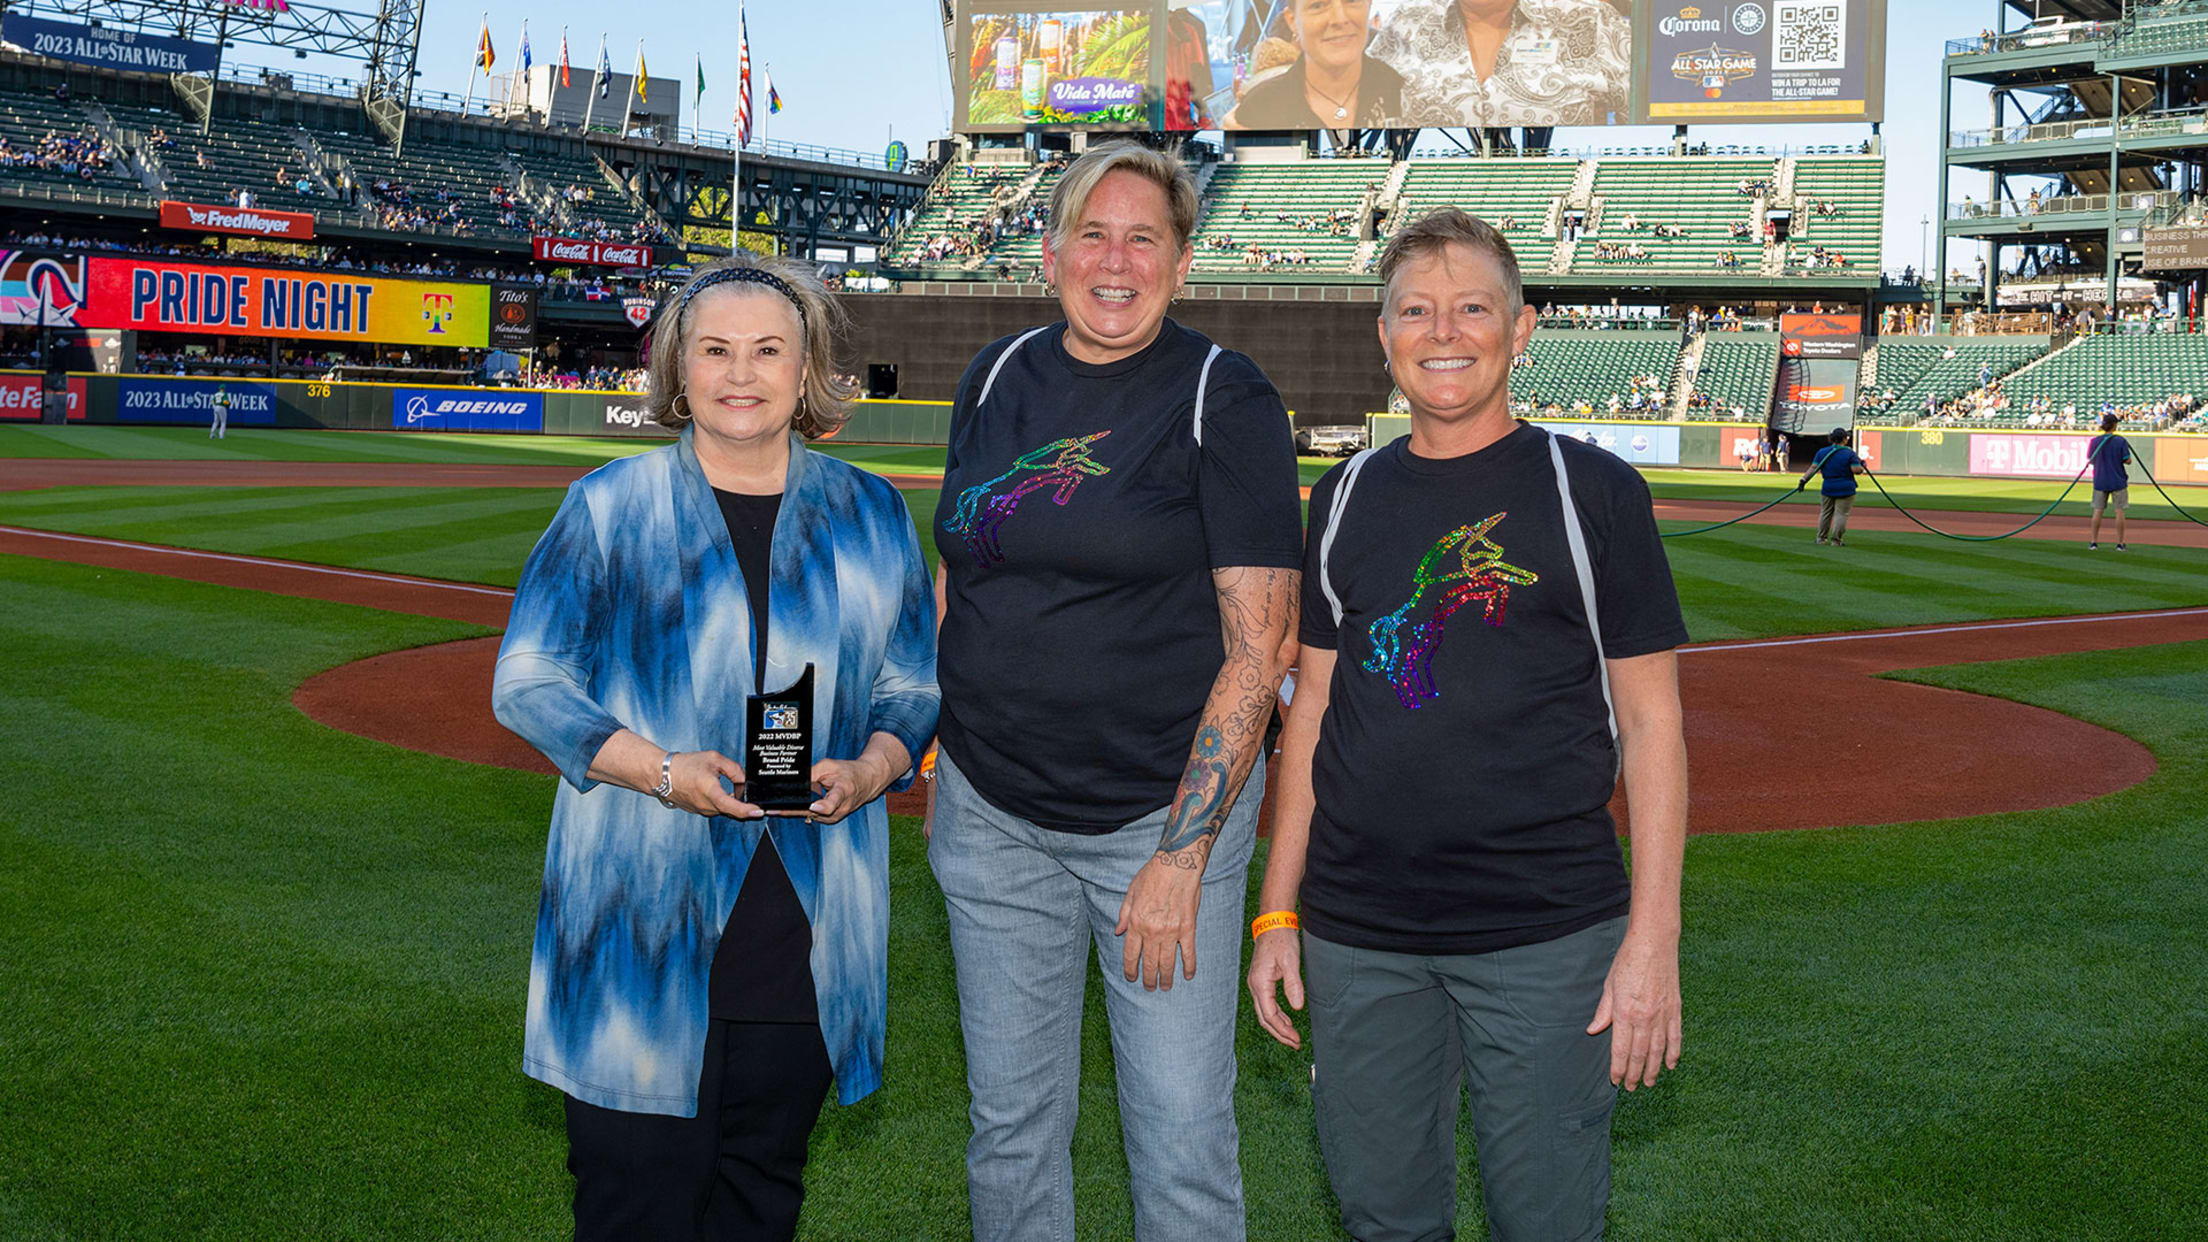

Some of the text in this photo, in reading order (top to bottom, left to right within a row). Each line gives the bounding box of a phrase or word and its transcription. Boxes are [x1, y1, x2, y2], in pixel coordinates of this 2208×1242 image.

[1659, 16, 1721, 37] Corona
[90, 27, 137, 45] HOME OF
[34, 33, 73, 54] 2023
[145, 49, 188, 71] WEEK
[1722, 57, 1757, 69] GAME
[1785, 78, 1791, 87] A
[1808, 78, 1817, 86] TO
[1817, 78, 1827, 86] LA
[1827, 77, 1841, 86] FOR
[1053, 82, 1136, 104] Vida Maté
[1771, 87, 1785, 96] THE
[2145, 231, 2190, 241] BUSINESS
[2145, 244, 2188, 255] CREATIVE
[2145, 258, 2162, 268] USE
[2164, 257, 2177, 267] OF
[131, 267, 374, 334] PRIDE NIGHT
[499, 290, 529, 303] Tito's
[630, 306, 647, 321] 42
[307, 384, 331, 398] 376
[125, 391, 161, 408] 2023
[228, 393, 269, 411] WEEK
[435, 400, 528, 415] BOEING
[1779, 401, 1851, 412] TOYOTA
[1921, 431, 1944, 445] 380
[2012, 440, 2094, 471] Mobil
